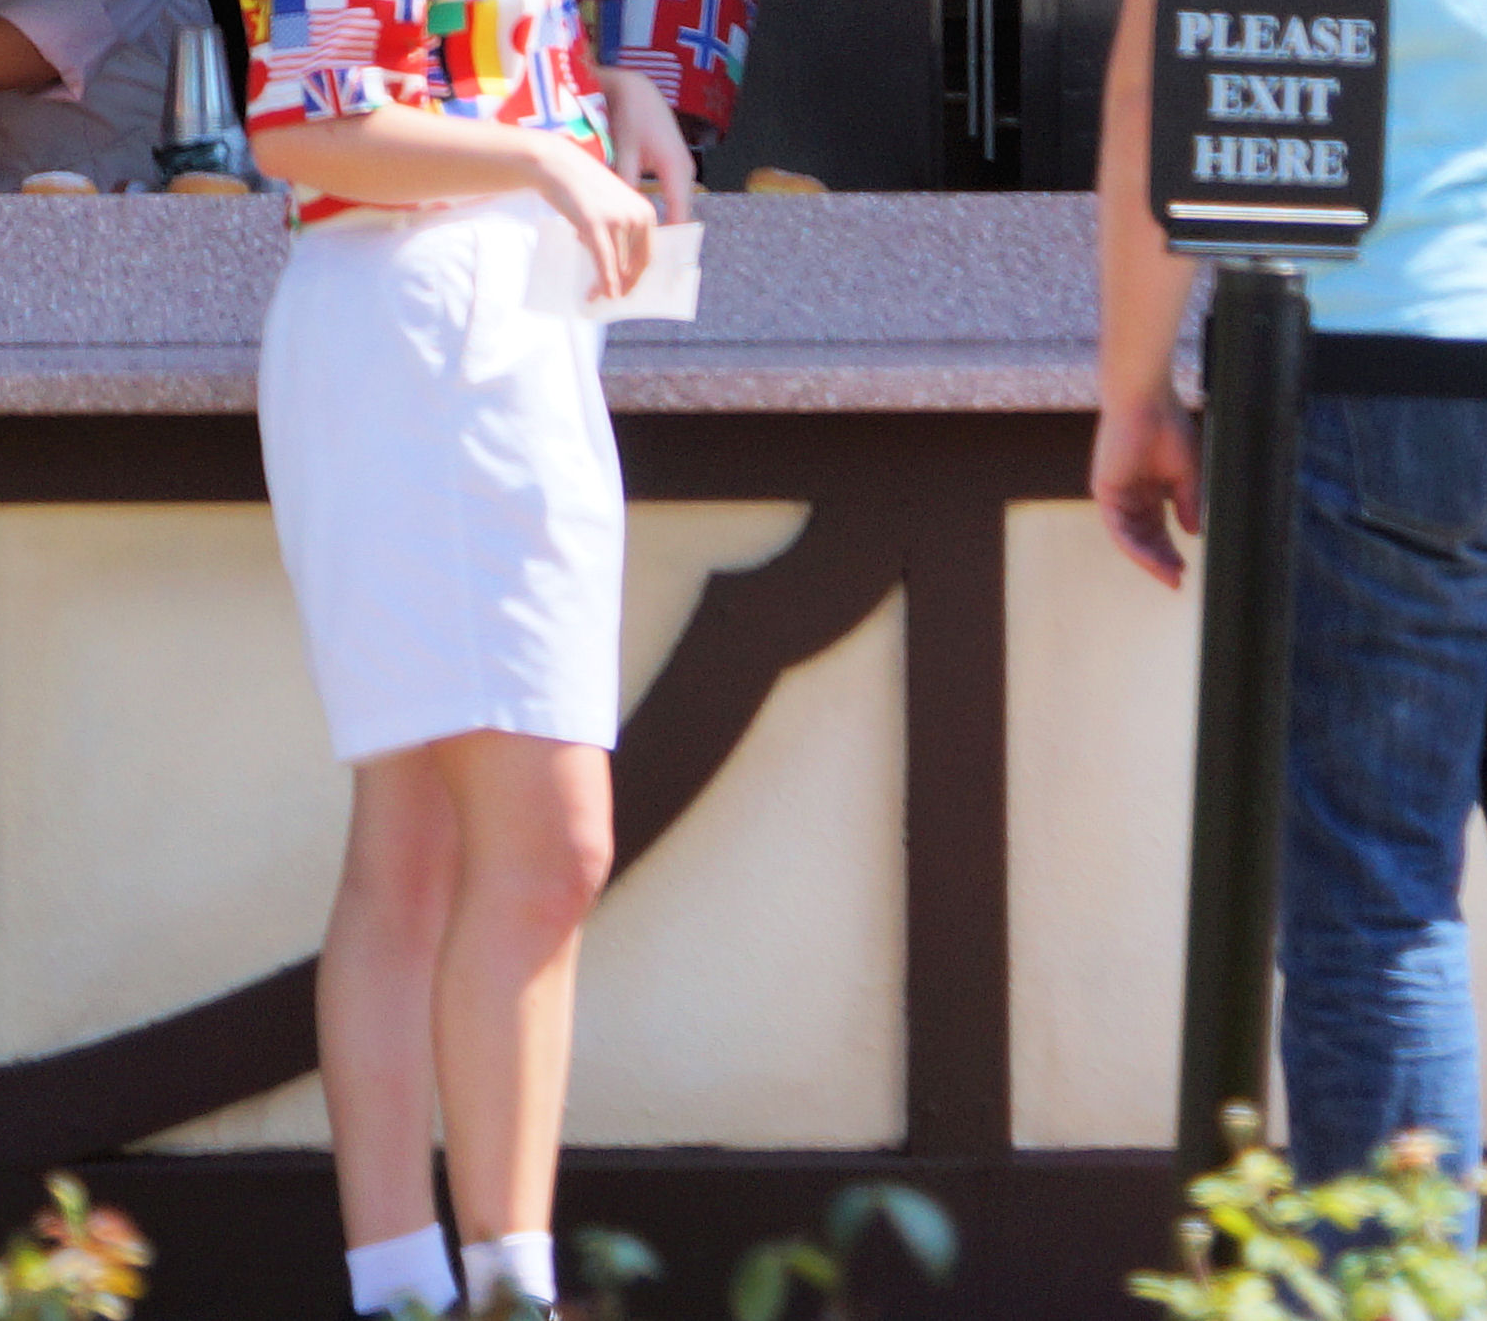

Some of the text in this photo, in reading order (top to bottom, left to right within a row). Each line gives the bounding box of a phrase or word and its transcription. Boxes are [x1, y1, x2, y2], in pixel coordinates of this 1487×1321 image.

[1177, 11, 1376, 66] PLEASE
[1206, 73, 1341, 124] EXIT
[1192, 135, 1349, 187] HERE
